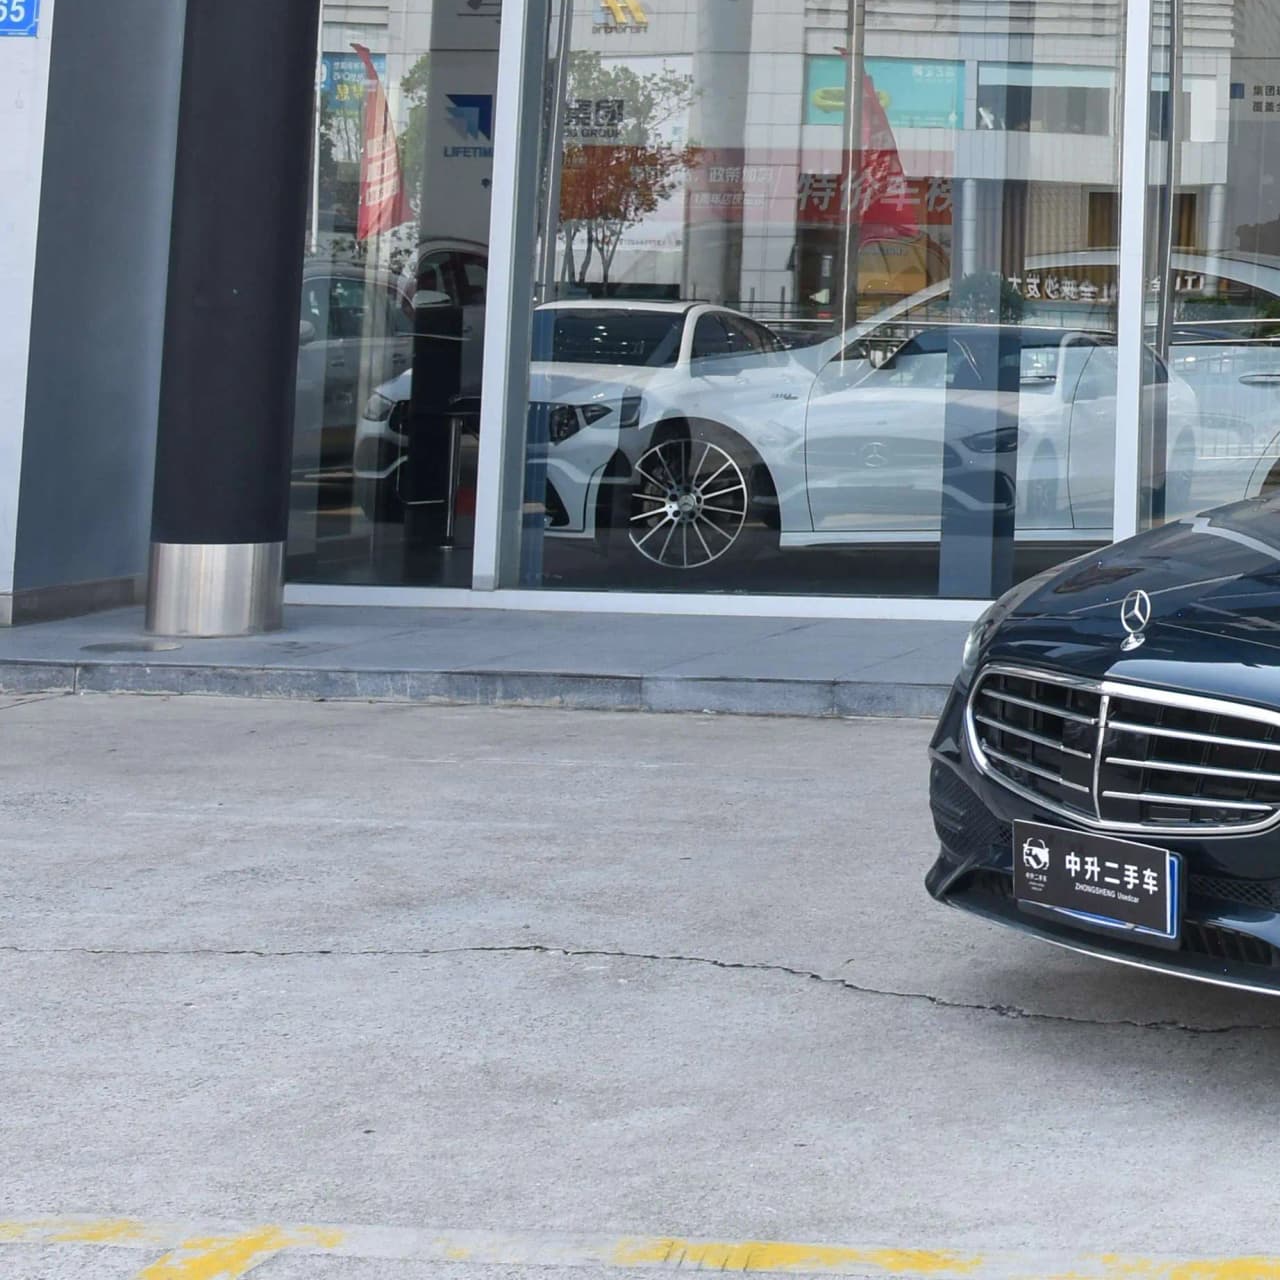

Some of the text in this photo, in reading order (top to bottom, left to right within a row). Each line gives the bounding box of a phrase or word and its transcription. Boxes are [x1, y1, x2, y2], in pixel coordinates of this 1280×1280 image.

[1065, 851, 1159, 895] 中升二手车
[1074, 882, 1117, 898] ZHONGSHENG
